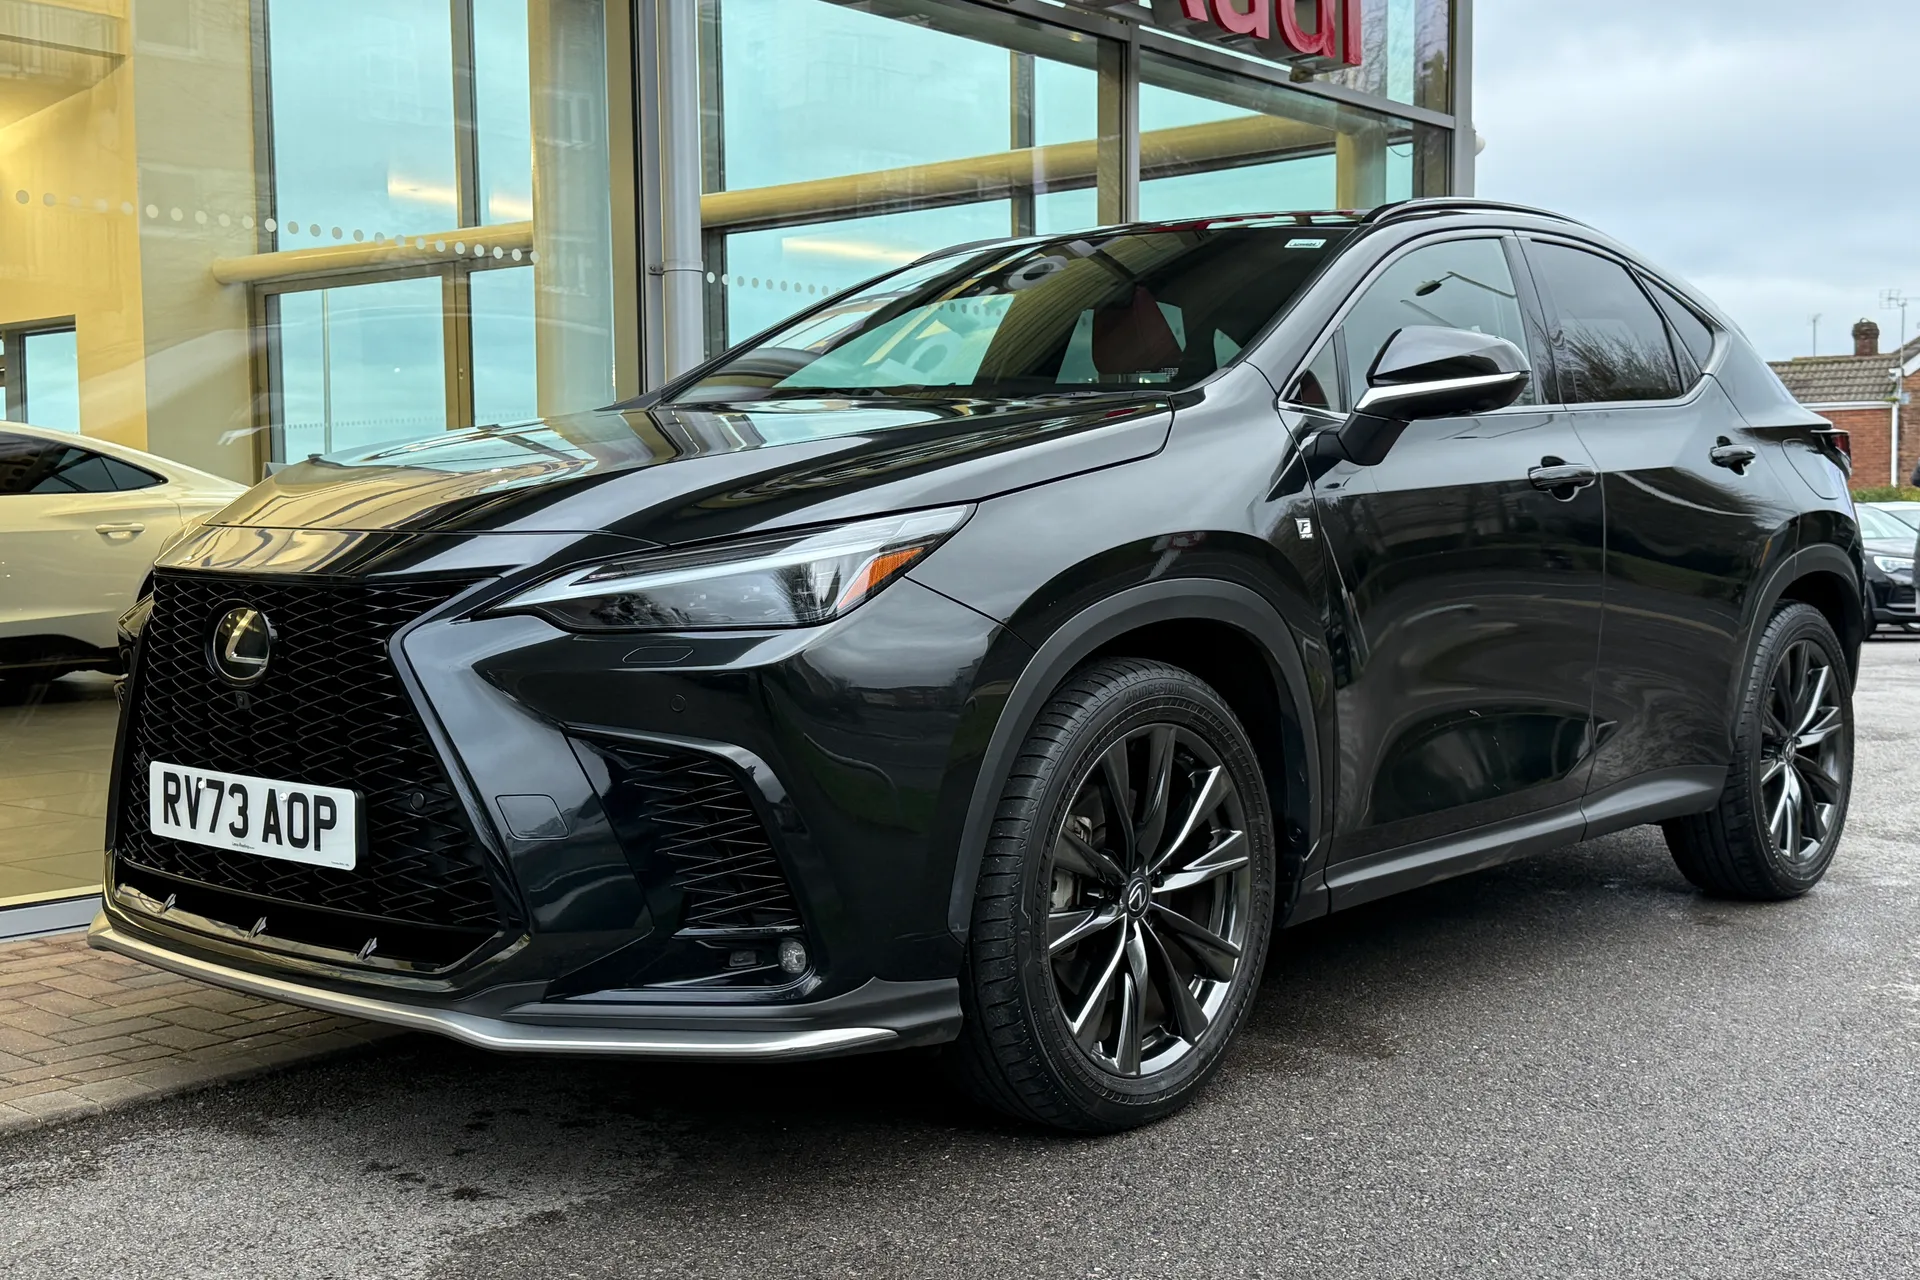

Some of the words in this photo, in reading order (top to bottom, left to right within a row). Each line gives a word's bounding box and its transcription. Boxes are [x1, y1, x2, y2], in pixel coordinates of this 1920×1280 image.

[1180, 0, 1362, 66] udi
[163, 771, 249, 838] RV73
[262, 788, 337, 851] AOP
